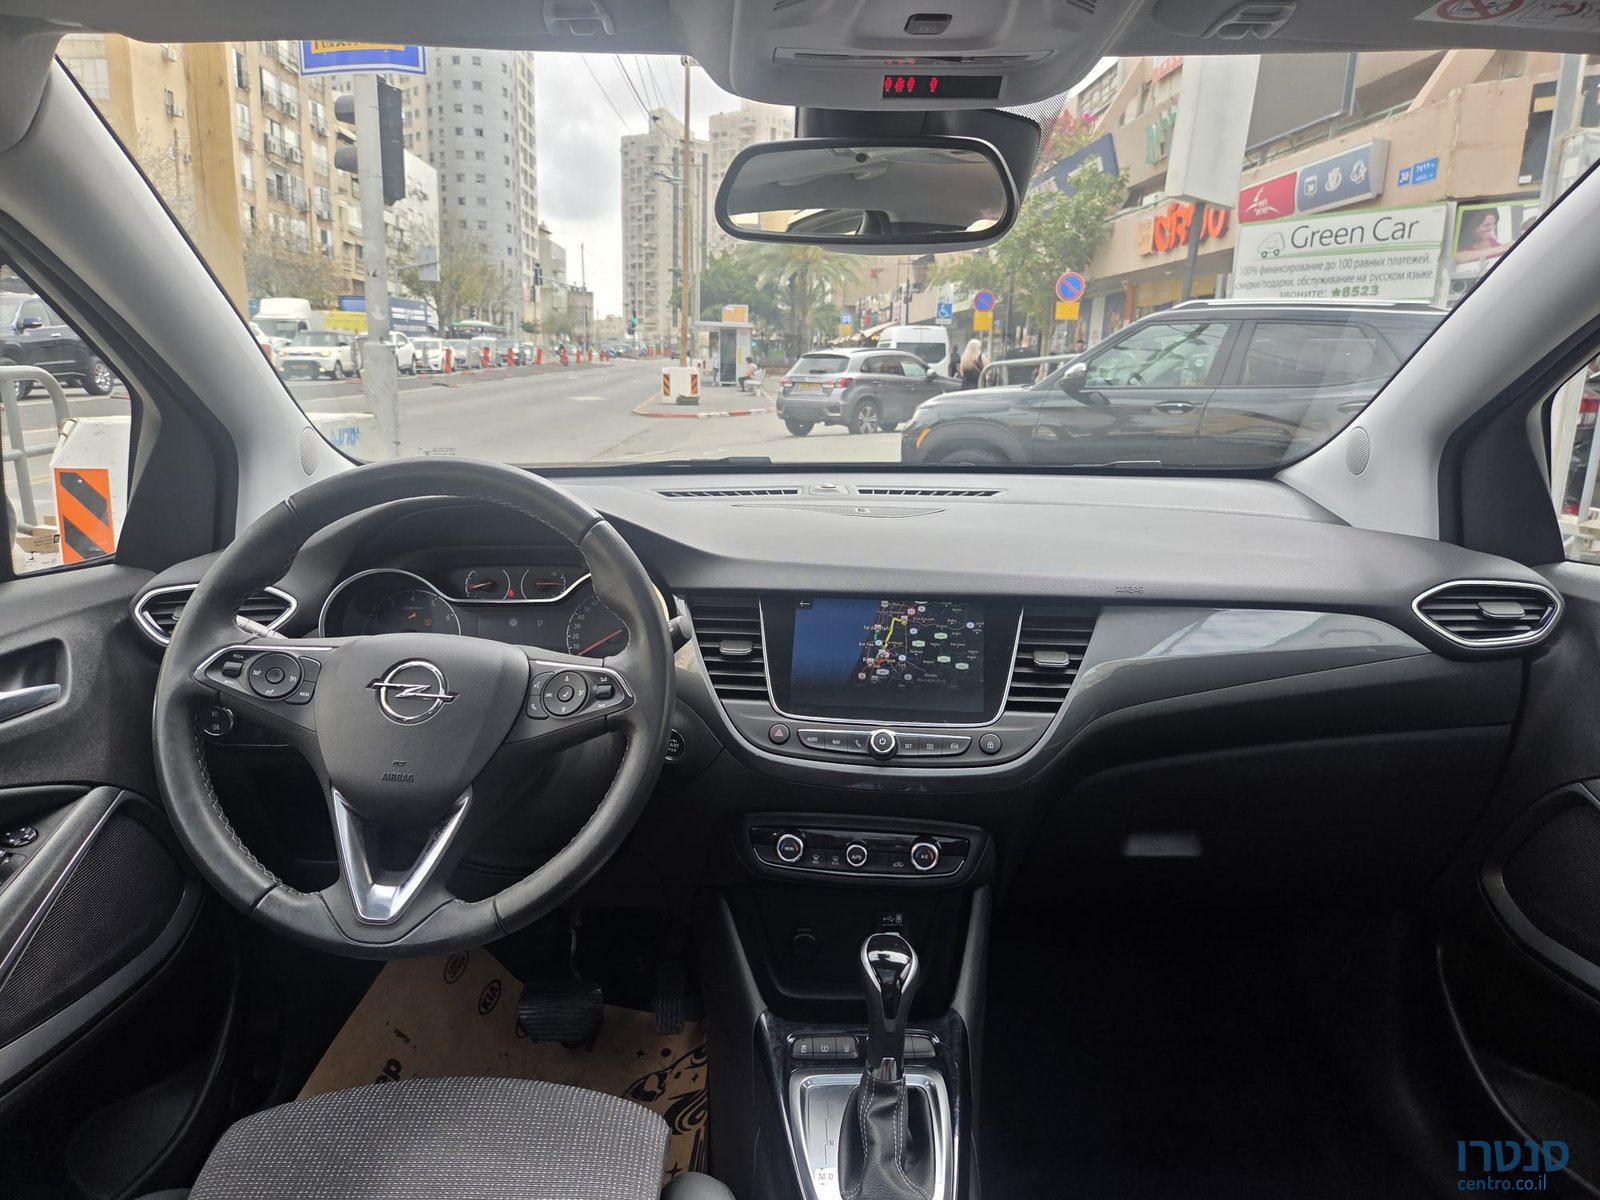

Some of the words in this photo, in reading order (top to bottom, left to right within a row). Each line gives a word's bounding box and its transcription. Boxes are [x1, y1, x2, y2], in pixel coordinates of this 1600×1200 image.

[1291, 225, 1365, 249] Green
[1373, 216, 1420, 242] Car
[1339, 258, 1352, 270] 100
[1356, 273, 1367, 283] на
[1369, 270, 1404, 285] русском
[381, 772, 415, 783] AIRBAG
[481, 984, 500, 1010] KIA
